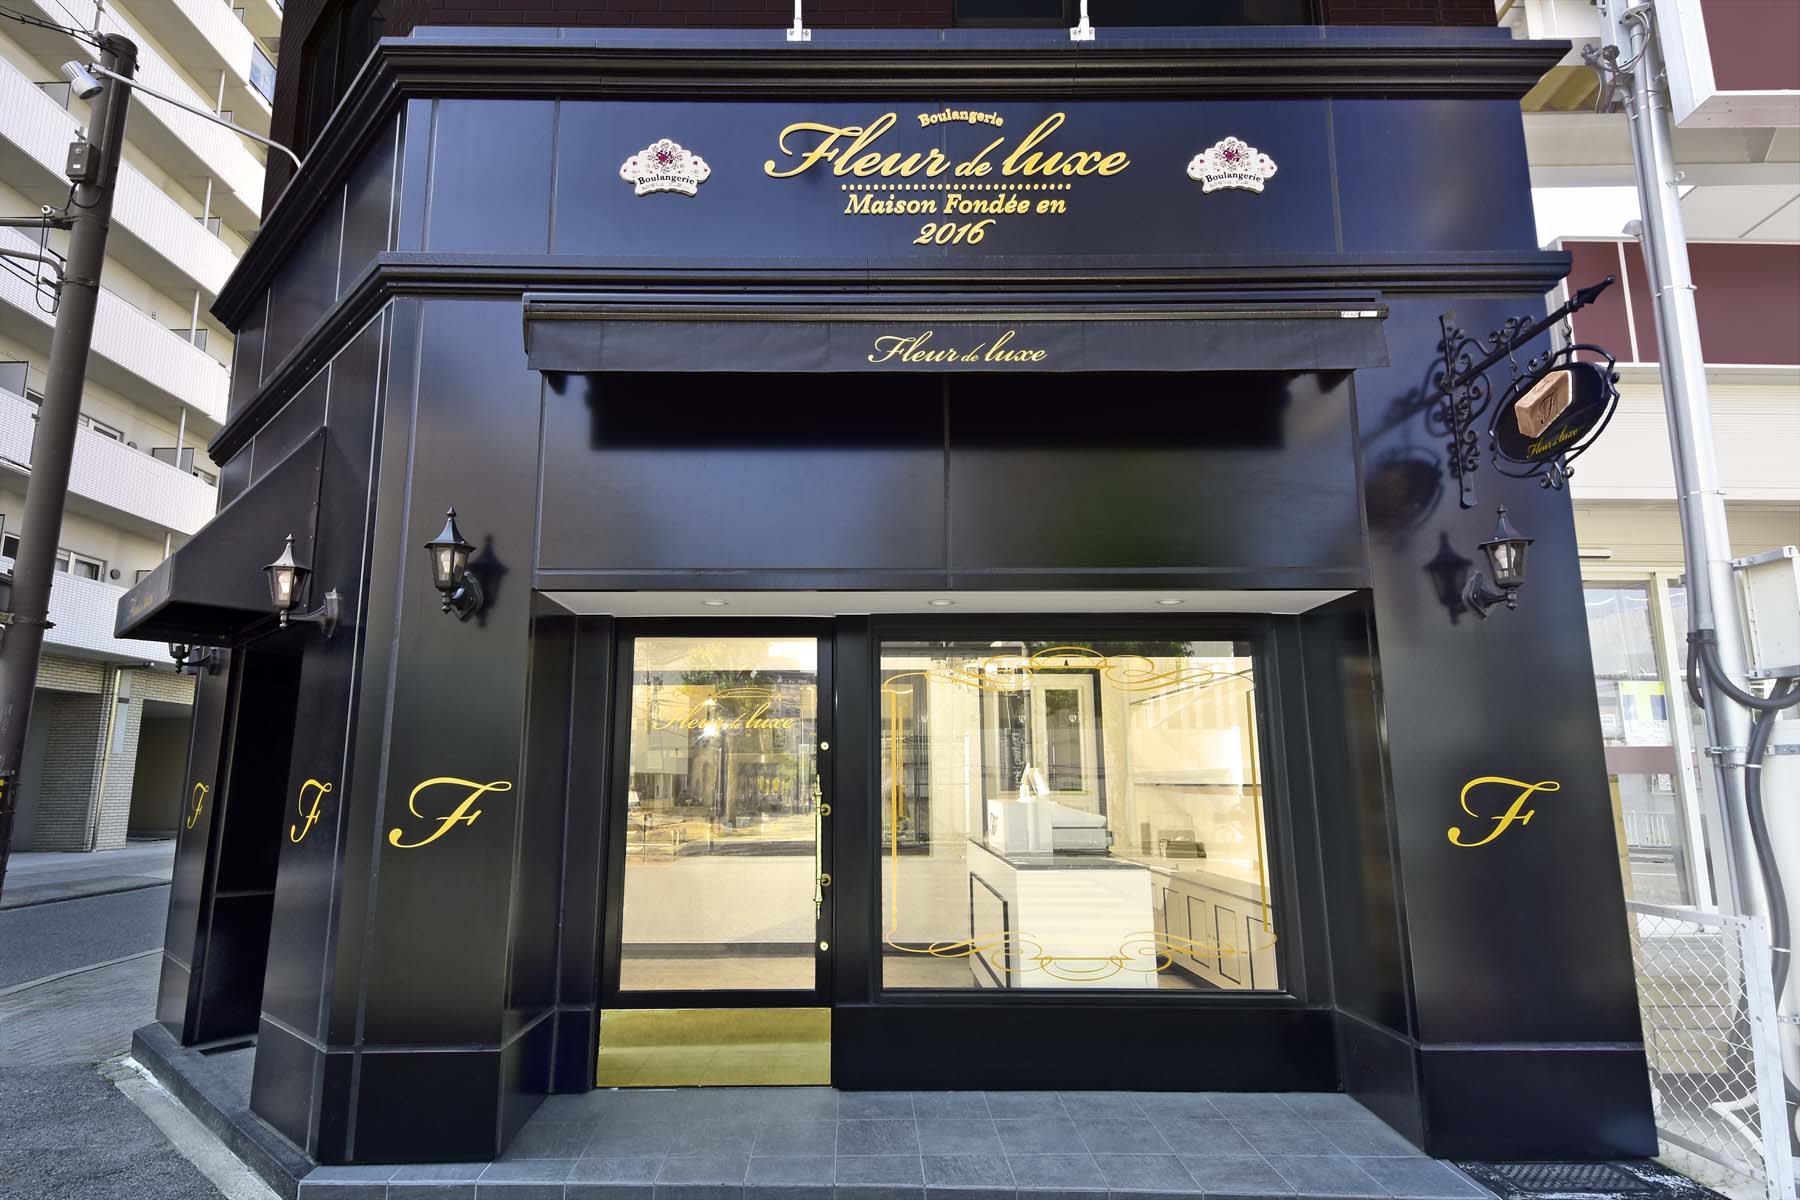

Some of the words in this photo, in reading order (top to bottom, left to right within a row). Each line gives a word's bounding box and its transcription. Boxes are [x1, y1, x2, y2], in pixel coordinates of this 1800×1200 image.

[918, 109, 1004, 127] Boulangerie
[764, 113, 950, 177] Fleur
[955, 137, 1005, 177] de
[1002, 112, 1130, 176] luxe
[638, 173, 695, 185] Boulangerie
[1205, 171, 1262, 183] Boulangerie
[845, 193, 937, 214] Maison
[944, 193, 1030, 214] Fondée
[1036, 199, 1067, 214] en
[913, 219, 996, 245] 2016
[868, 330, 959, 363] Fleur
[961, 342, 986, 362] de
[985, 330, 1047, 362] luxe
[745, 702, 794, 729] luxe
[187, 782, 209, 829] F
[290, 778, 333, 843] F
[388, 776, 512, 848] F
[1448, 776, 1560, 847] F
